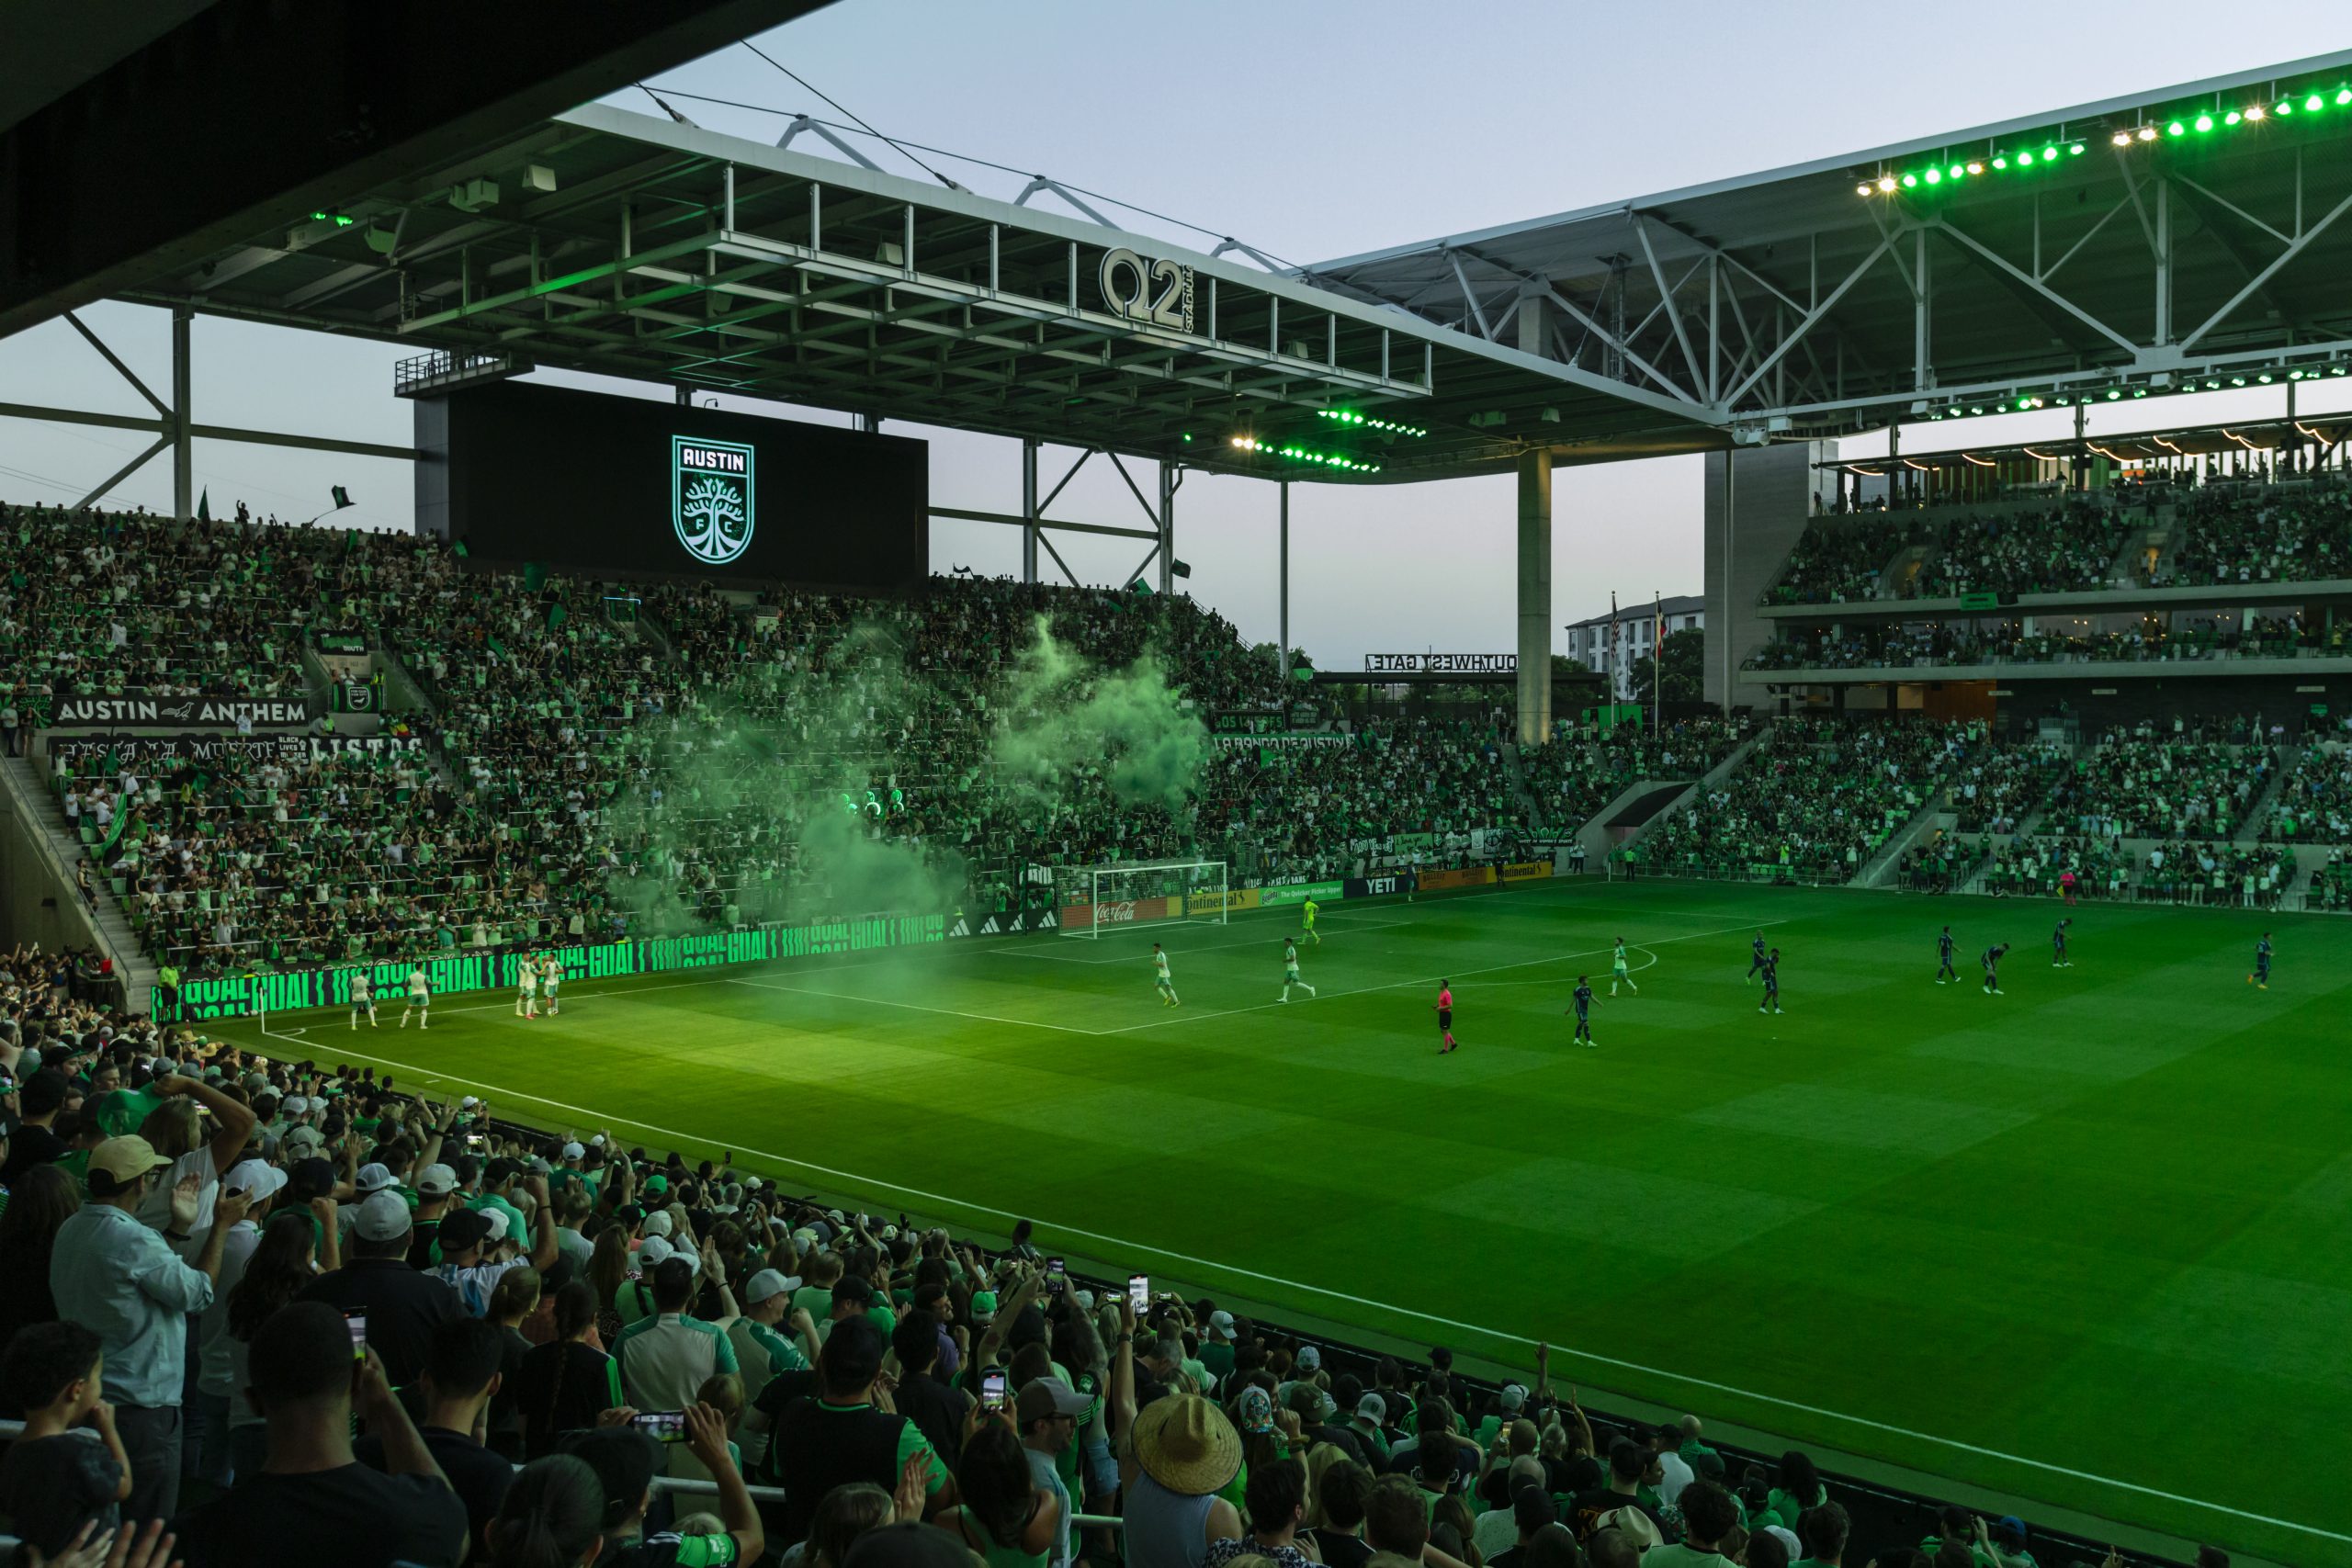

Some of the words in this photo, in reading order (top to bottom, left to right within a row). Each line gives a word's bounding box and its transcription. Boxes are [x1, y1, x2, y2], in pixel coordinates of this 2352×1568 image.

[1099, 246, 1183, 332] Q2
[1182, 264, 1194, 333] STADIUM
[683, 448, 744, 471] AUSTIN
[58, 700, 158, 721] AUSTIN
[198, 703, 306, 722] ANTHEM
[1365, 877, 1394, 895] YETI
[589, 942, 637, 977] GOAL
[728, 931, 769, 963] GOAL
[432, 956, 485, 994] GOAL
